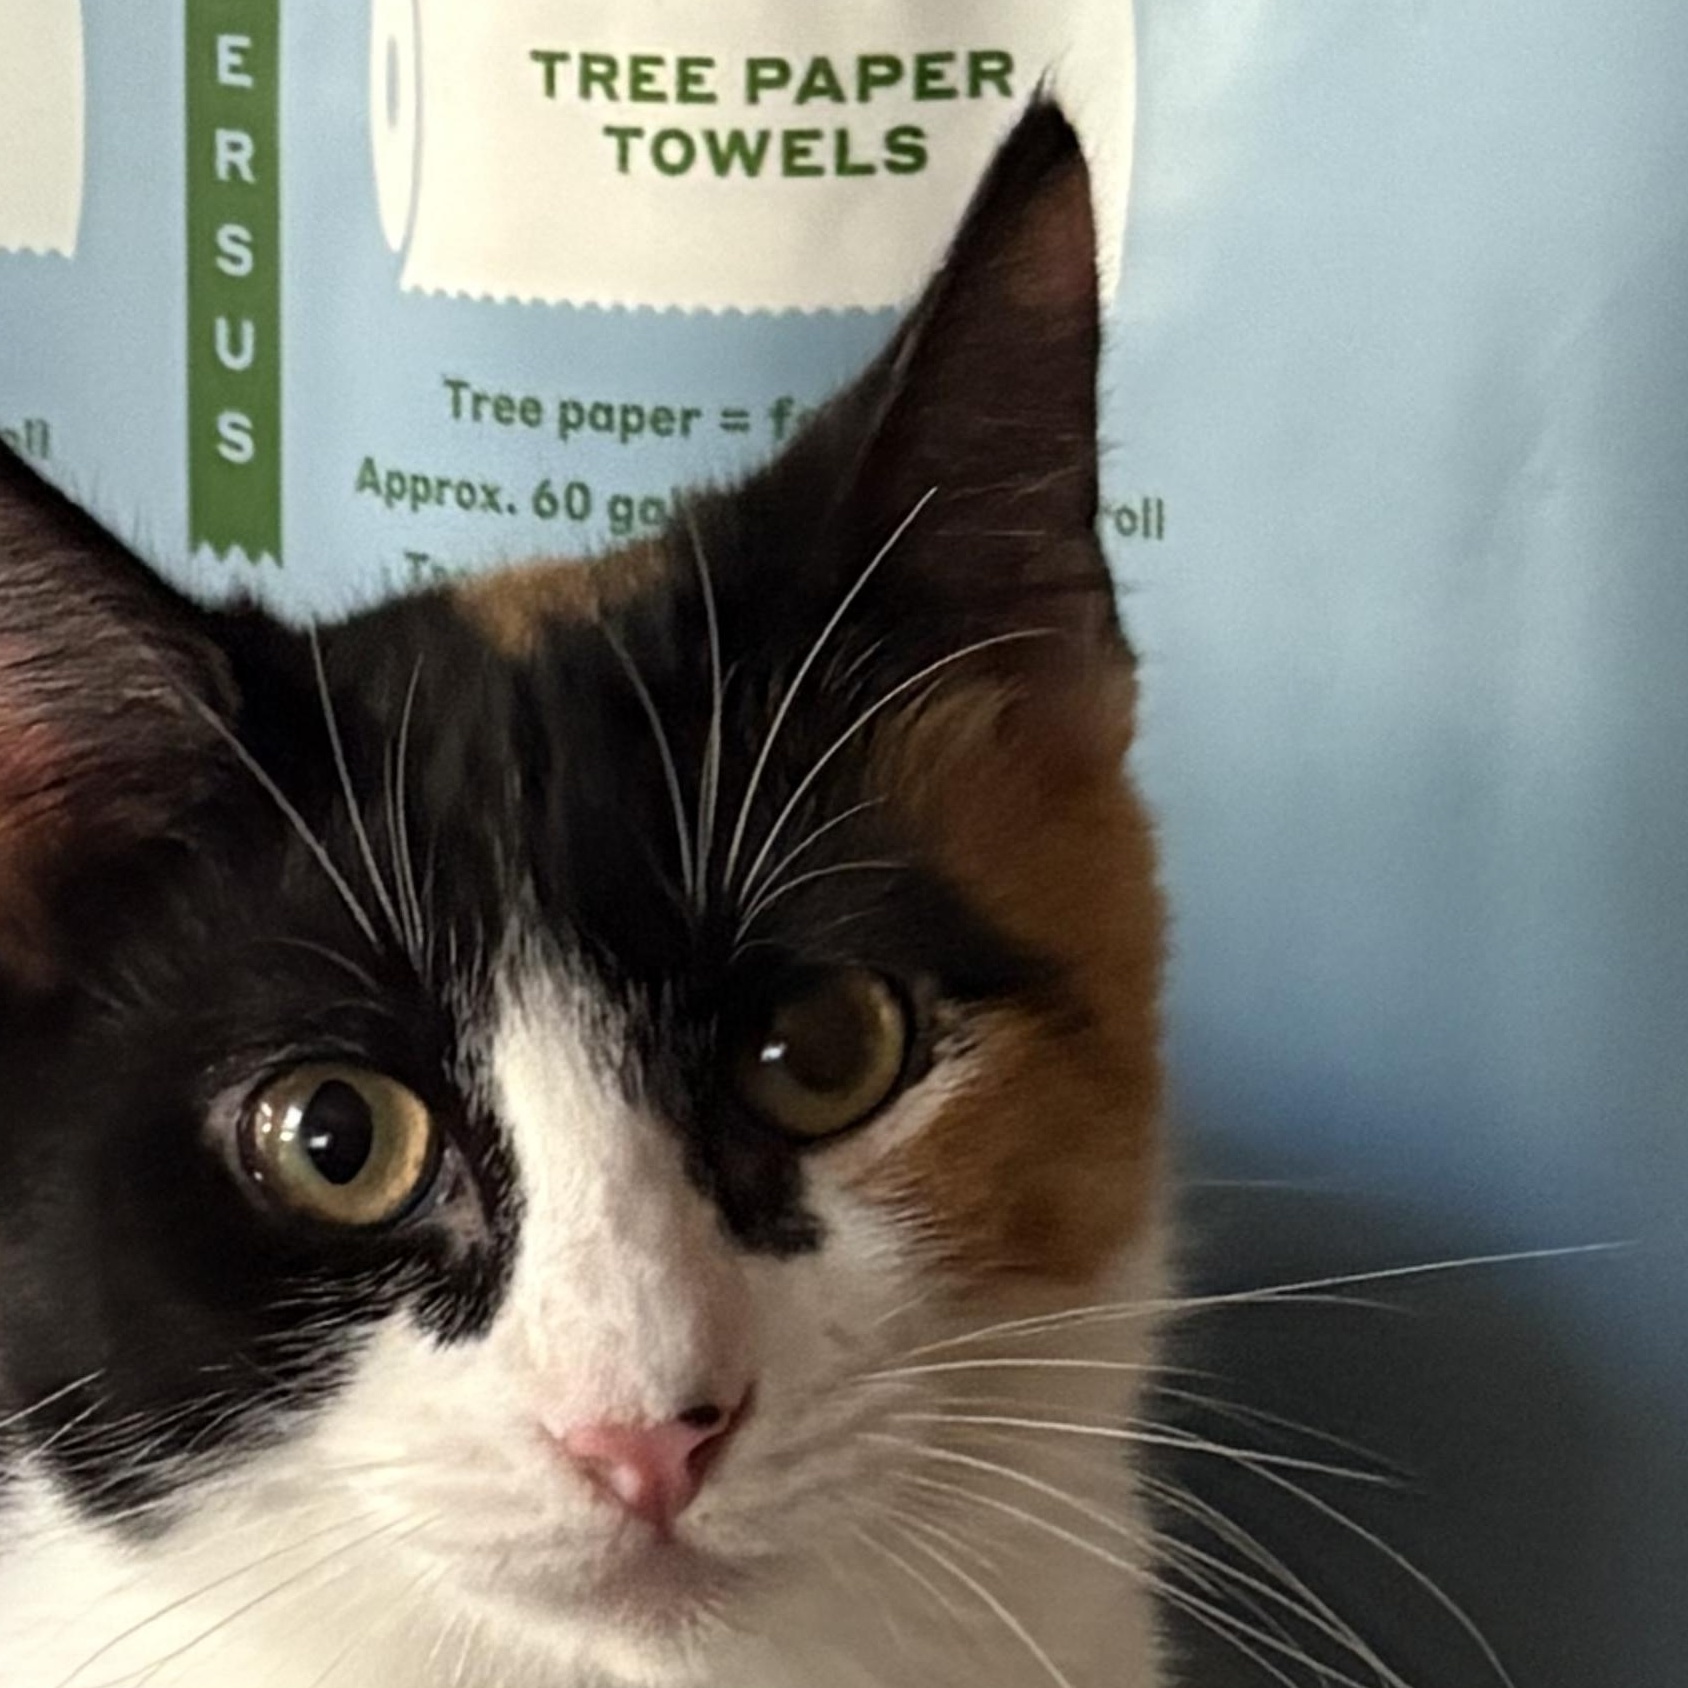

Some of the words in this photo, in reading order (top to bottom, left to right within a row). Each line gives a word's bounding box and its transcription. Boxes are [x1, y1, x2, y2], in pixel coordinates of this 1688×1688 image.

[529, 50, 719, 104] TREE
[744, 50, 1016, 106] PAPER
[603, 125, 930, 178] TOWELS
[442, 377, 544, 428] Tree
[558, 397, 703, 444] paper
[356, 456, 518, 513] Approx.
[531, 477, 592, 522] 60
